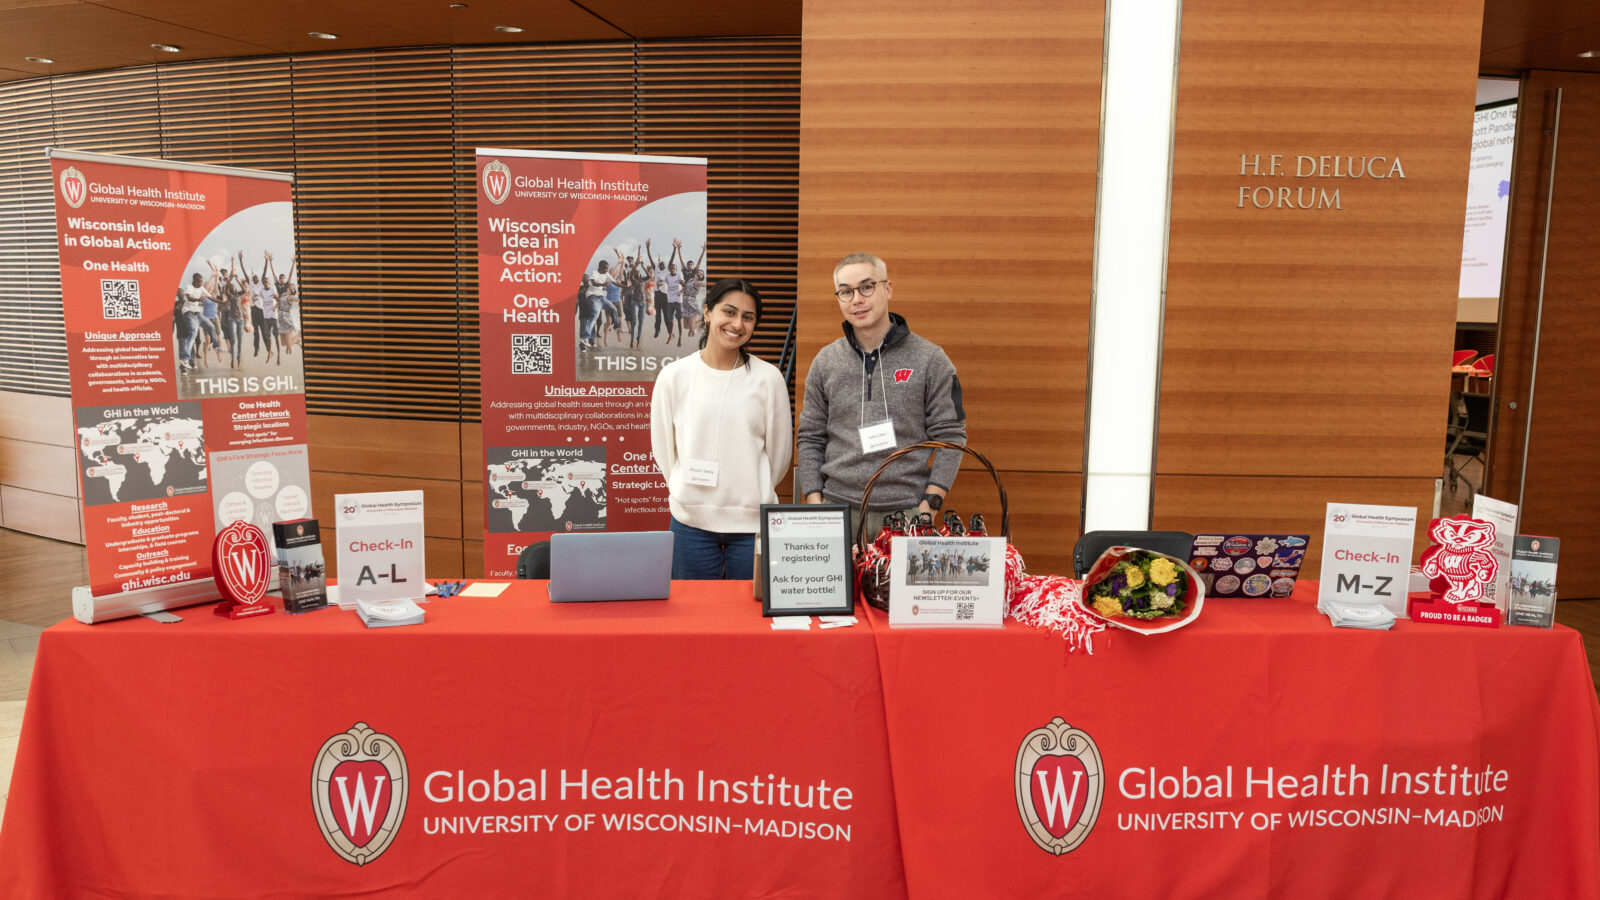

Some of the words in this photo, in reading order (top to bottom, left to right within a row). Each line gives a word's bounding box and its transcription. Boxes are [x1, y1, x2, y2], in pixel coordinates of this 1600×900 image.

[1491, 110, 1507, 120] One
[1239, 154, 1284, 176] H.F.
[1295, 155, 1405, 178] DELUCA
[66, 181, 80, 201] W
[490, 175, 506, 197] W
[515, 176, 554, 189] Global
[557, 177, 596, 190] Health
[600, 179, 649, 192] Institute
[89, 182, 124, 195] Global
[128, 186, 161, 198] Health
[165, 189, 205, 201] Institute
[515, 191, 557, 199] UNIVERSITY
[1237, 186, 1343, 210] FORUM
[68, 217, 134, 232] Wisconsin
[138, 222, 164, 233] Idea
[488, 217, 575, 234] Wisconsin
[65, 234, 77, 246] in
[80, 236, 123, 248] Global
[127, 238, 171, 250] Action:
[502, 233, 540, 249] Idea
[544, 234, 558, 248] in
[502, 251, 558, 266] Global
[83, 260, 108, 271] One
[111, 261, 149, 272] Health
[500, 268, 561, 283] Action:
[513, 294, 549, 308] One
[503, 308, 559, 323] Health
[85, 332, 117, 340] Unique
[119, 331, 160, 340] Approach
[595, 356, 637, 371] THIS
[642, 357, 657, 370] IS
[196, 377, 239, 394] THIS
[243, 376, 259, 392] IS
[263, 376, 298, 391] GHI.
[545, 385, 586, 397] Unique
[589, 385, 645, 397] Approach
[104, 410, 122, 418] GHI
[123, 409, 131, 417] in
[133, 408, 149, 416] the
[151, 406, 178, 415] World
[490, 401, 532, 409] Addressing
[534, 401, 556, 409] global
[605, 401, 634, 409] through
[232, 412, 257, 420] Center
[259, 410, 290, 418] Network
[526, 412, 584, 420] multidisciplinary
[234, 423, 262, 431] Strategic
[506, 424, 557, 432] governments,
[558, 423, 589, 431] industry,
[590, 423, 614, 431] NGOs,
[511, 450, 529, 458] GHI
[540, 449, 555, 457] the
[557, 449, 583, 457] World
[623, 452, 646, 461] One
[611, 464, 650, 473] Center
[612, 482, 652, 490] Strategic
[131, 501, 167, 512] Research
[132, 525, 170, 534] Education
[151, 534, 174, 542] graduate
[350, 539, 413, 552] Check-In
[136, 549, 168, 559] Outreach
[781, 554, 831, 563] registering!
[1335, 550, 1399, 563] Check-In
[231, 549, 256, 586] W
[356, 563, 407, 586] A-L
[122, 571, 190, 592] ghi.wisc.edu
[773, 575, 788, 583] Ask
[806, 576, 824, 584] your
[1337, 574, 1393, 596] M-Z
[807, 586, 835, 594] bottle!
[1453, 613, 1460, 621] BE
[1468, 615, 1492, 623] BADGER
[423, 769, 547, 803] Global
[560, 767, 685, 801] Health
[698, 769, 853, 811] Institute
[1119, 765, 1233, 800] Global
[1246, 764, 1368, 800] Health
[1381, 764, 1509, 797] Institute
[335, 771, 386, 837] W
[1036, 765, 1083, 829] W
[423, 814, 559, 835] UNIVERSITY
[564, 813, 596, 833] OF
[1118, 810, 1241, 831] UNIVERSITY
[1251, 812, 1282, 831] OF
